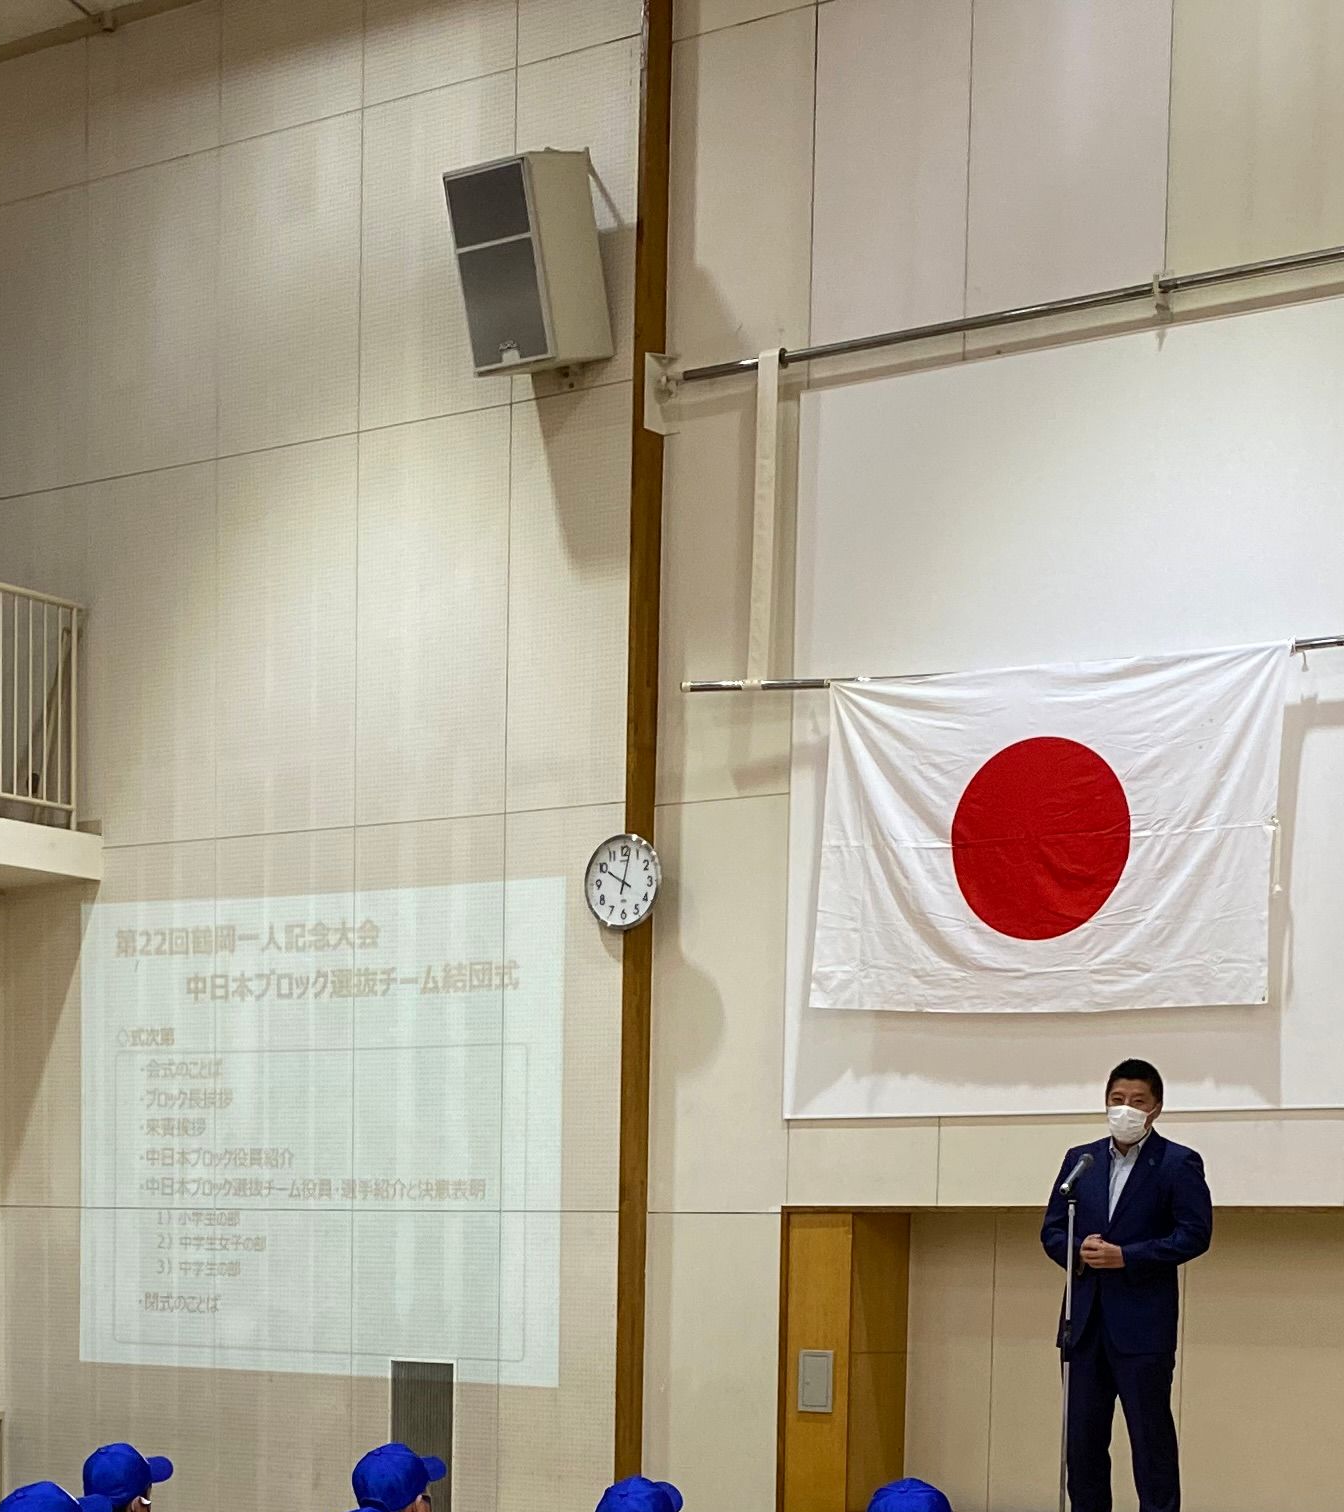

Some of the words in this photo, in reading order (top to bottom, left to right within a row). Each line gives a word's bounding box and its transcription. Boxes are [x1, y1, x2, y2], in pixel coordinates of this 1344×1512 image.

[609, 850, 616, 862] 11
[620, 845, 631, 856] 12
[599, 862, 608, 873] 10
[643, 860, 649, 871] 2
[596, 879, 602, 890] 9
[647, 876, 653, 887] 3
[599, 894, 605, 906] 8
[642, 892, 649, 902] 4
[609, 905, 615, 916] 7
[620, 908, 627, 919] 6
[633, 904, 639, 915] 5
[186, 960, 519, 1001] 中日本ブロック選抜チーム結団式
